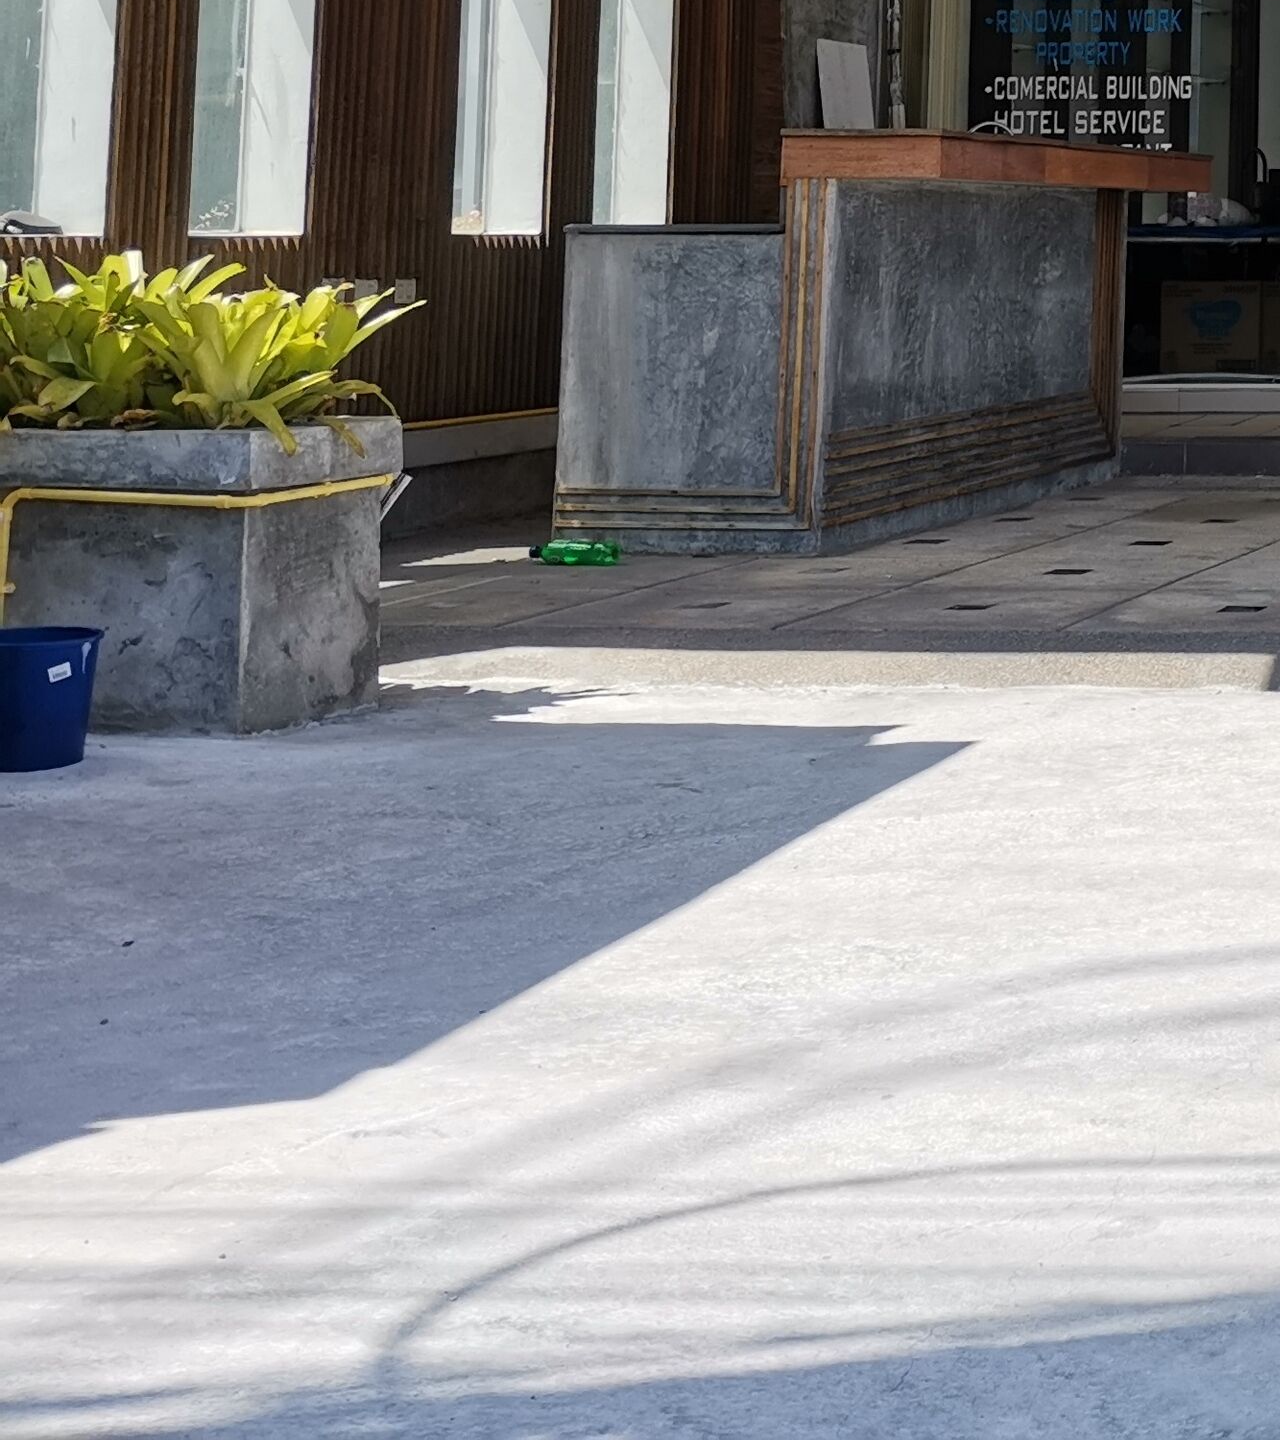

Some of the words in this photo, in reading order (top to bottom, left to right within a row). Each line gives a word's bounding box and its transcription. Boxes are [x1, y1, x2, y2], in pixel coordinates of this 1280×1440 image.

[996, 9, 1118, 33] RENOVATION
[1128, 8, 1183, 33] WORK
[1036, 41, 1131, 65] PROPERTY
[994, 75, 1099, 100] COMERCIAL
[1106, 75, 1193, 100] BUILDING
[994, 110, 1066, 135] HOTEL
[1074, 110, 1166, 135] SERVICE
